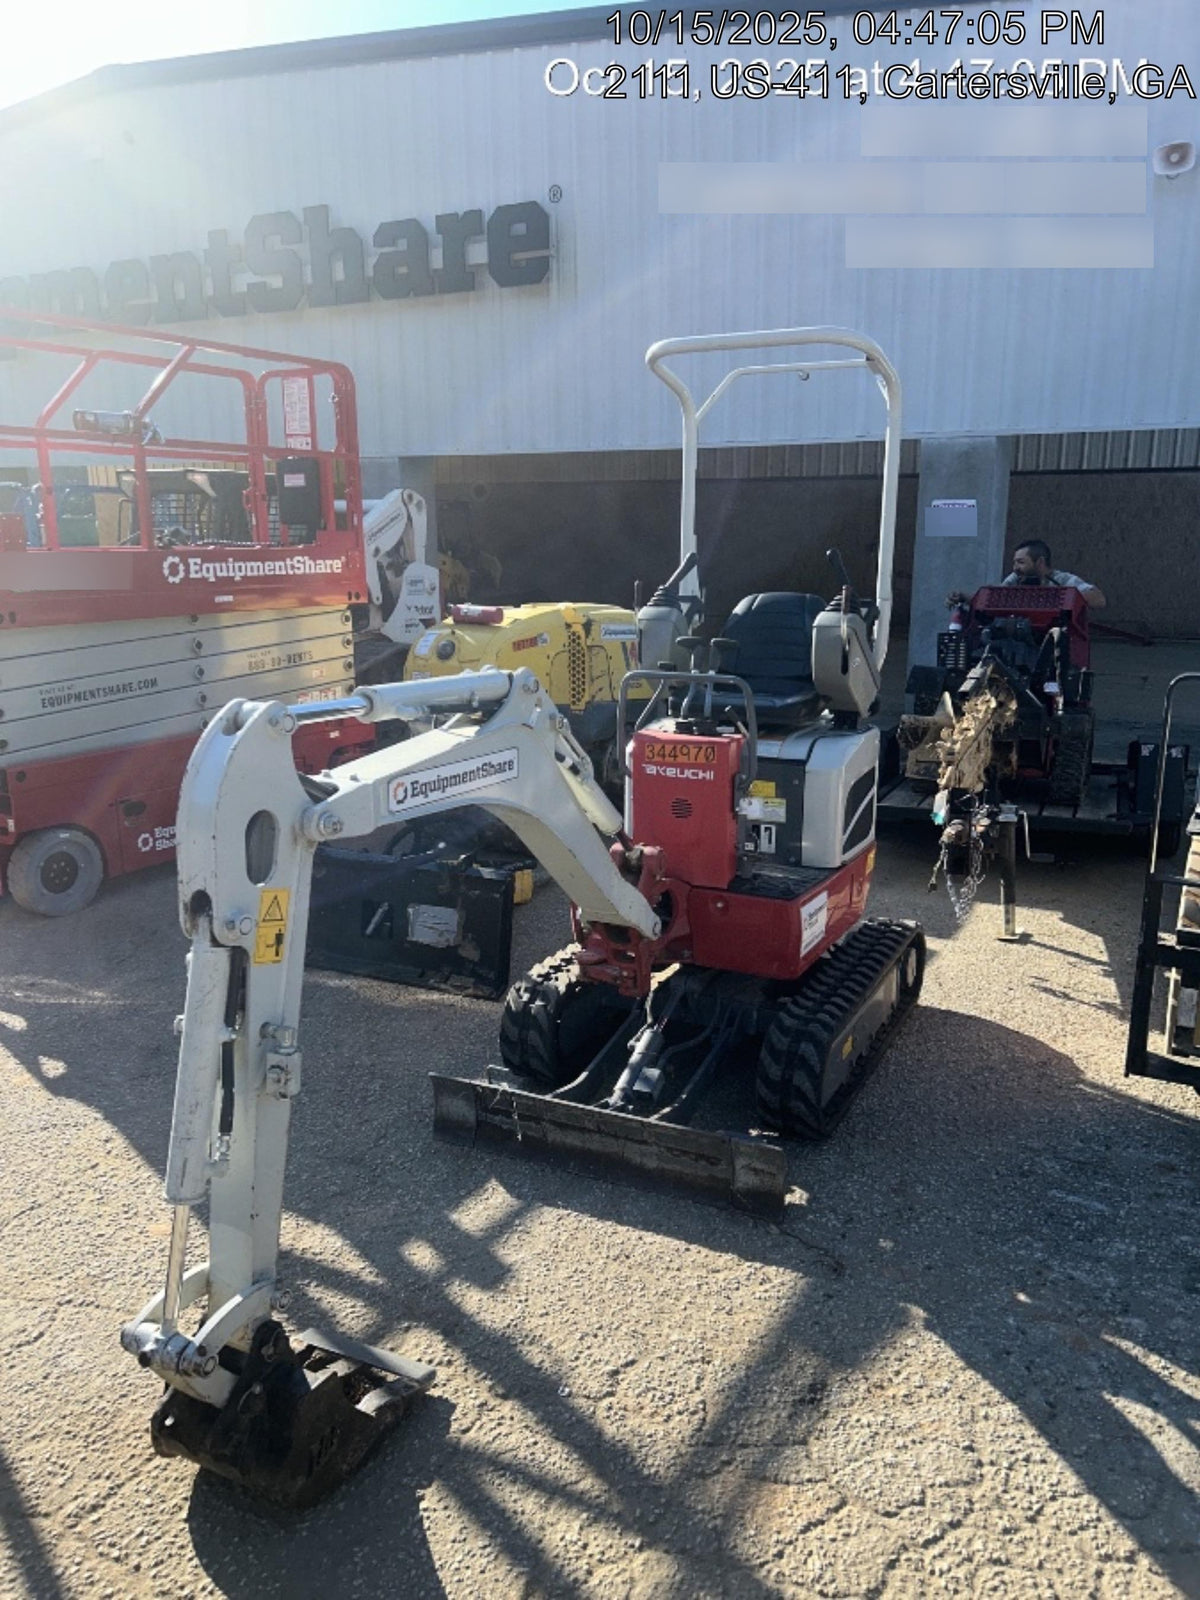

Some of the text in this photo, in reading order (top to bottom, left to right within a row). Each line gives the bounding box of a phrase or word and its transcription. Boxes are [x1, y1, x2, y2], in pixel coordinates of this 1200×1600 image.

[188, 556, 343, 582] EquipmentShare
[40, 677, 159, 709] EQUIPMENTSHARE.COM
[646, 744, 716, 763] 344970
[410, 758, 515, 799] EquipmentShare
